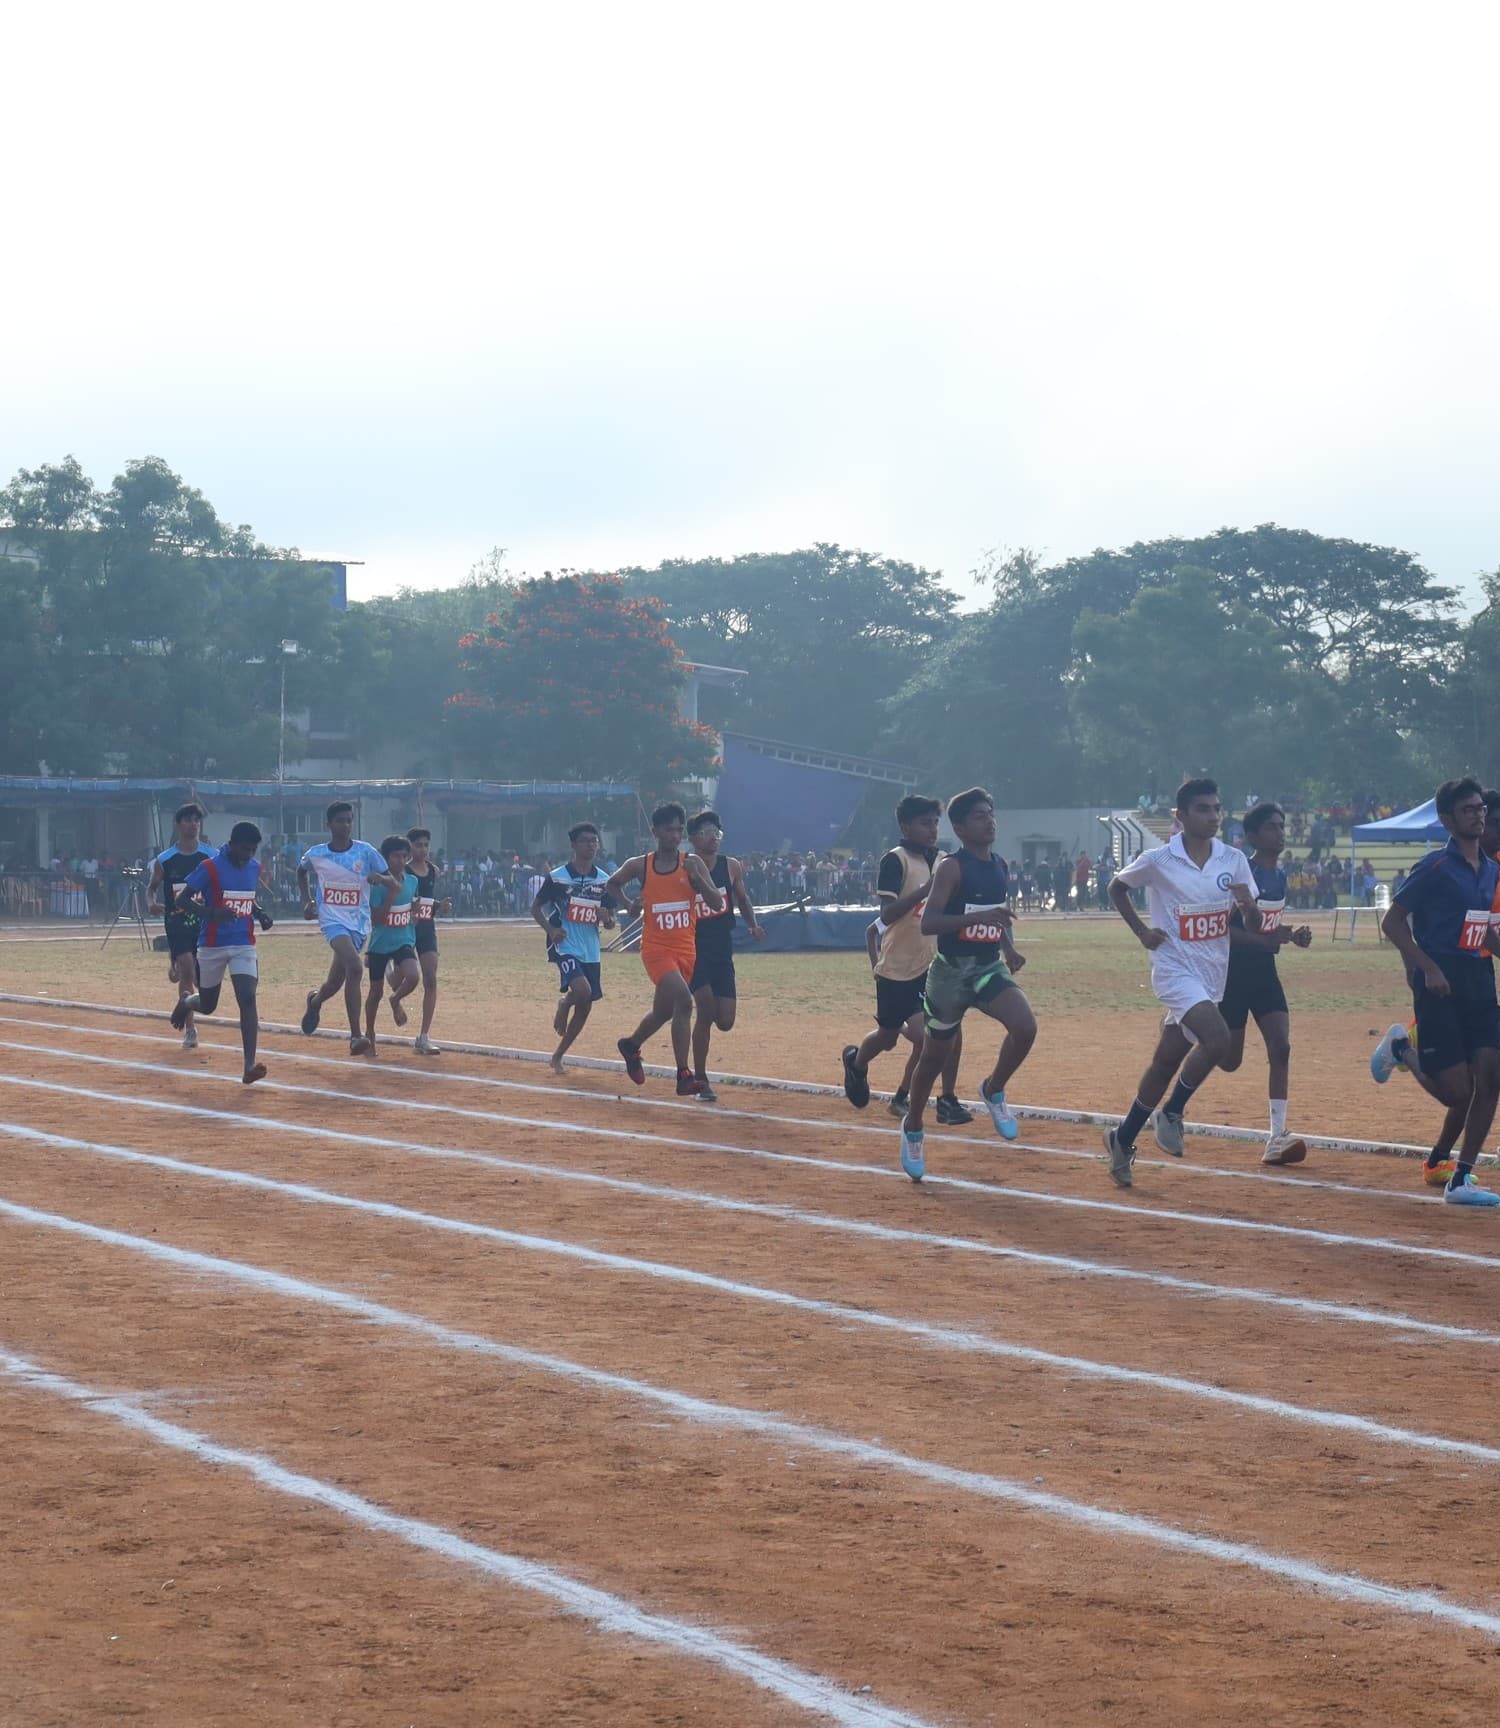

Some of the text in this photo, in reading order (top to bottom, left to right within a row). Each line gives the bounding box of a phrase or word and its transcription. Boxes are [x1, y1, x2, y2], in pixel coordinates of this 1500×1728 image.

[326, 890, 357, 905] 2063
[656, 912, 690, 930] 1918
[1185, 914, 1227, 939] 1953
[562, 958, 575, 974] 07
